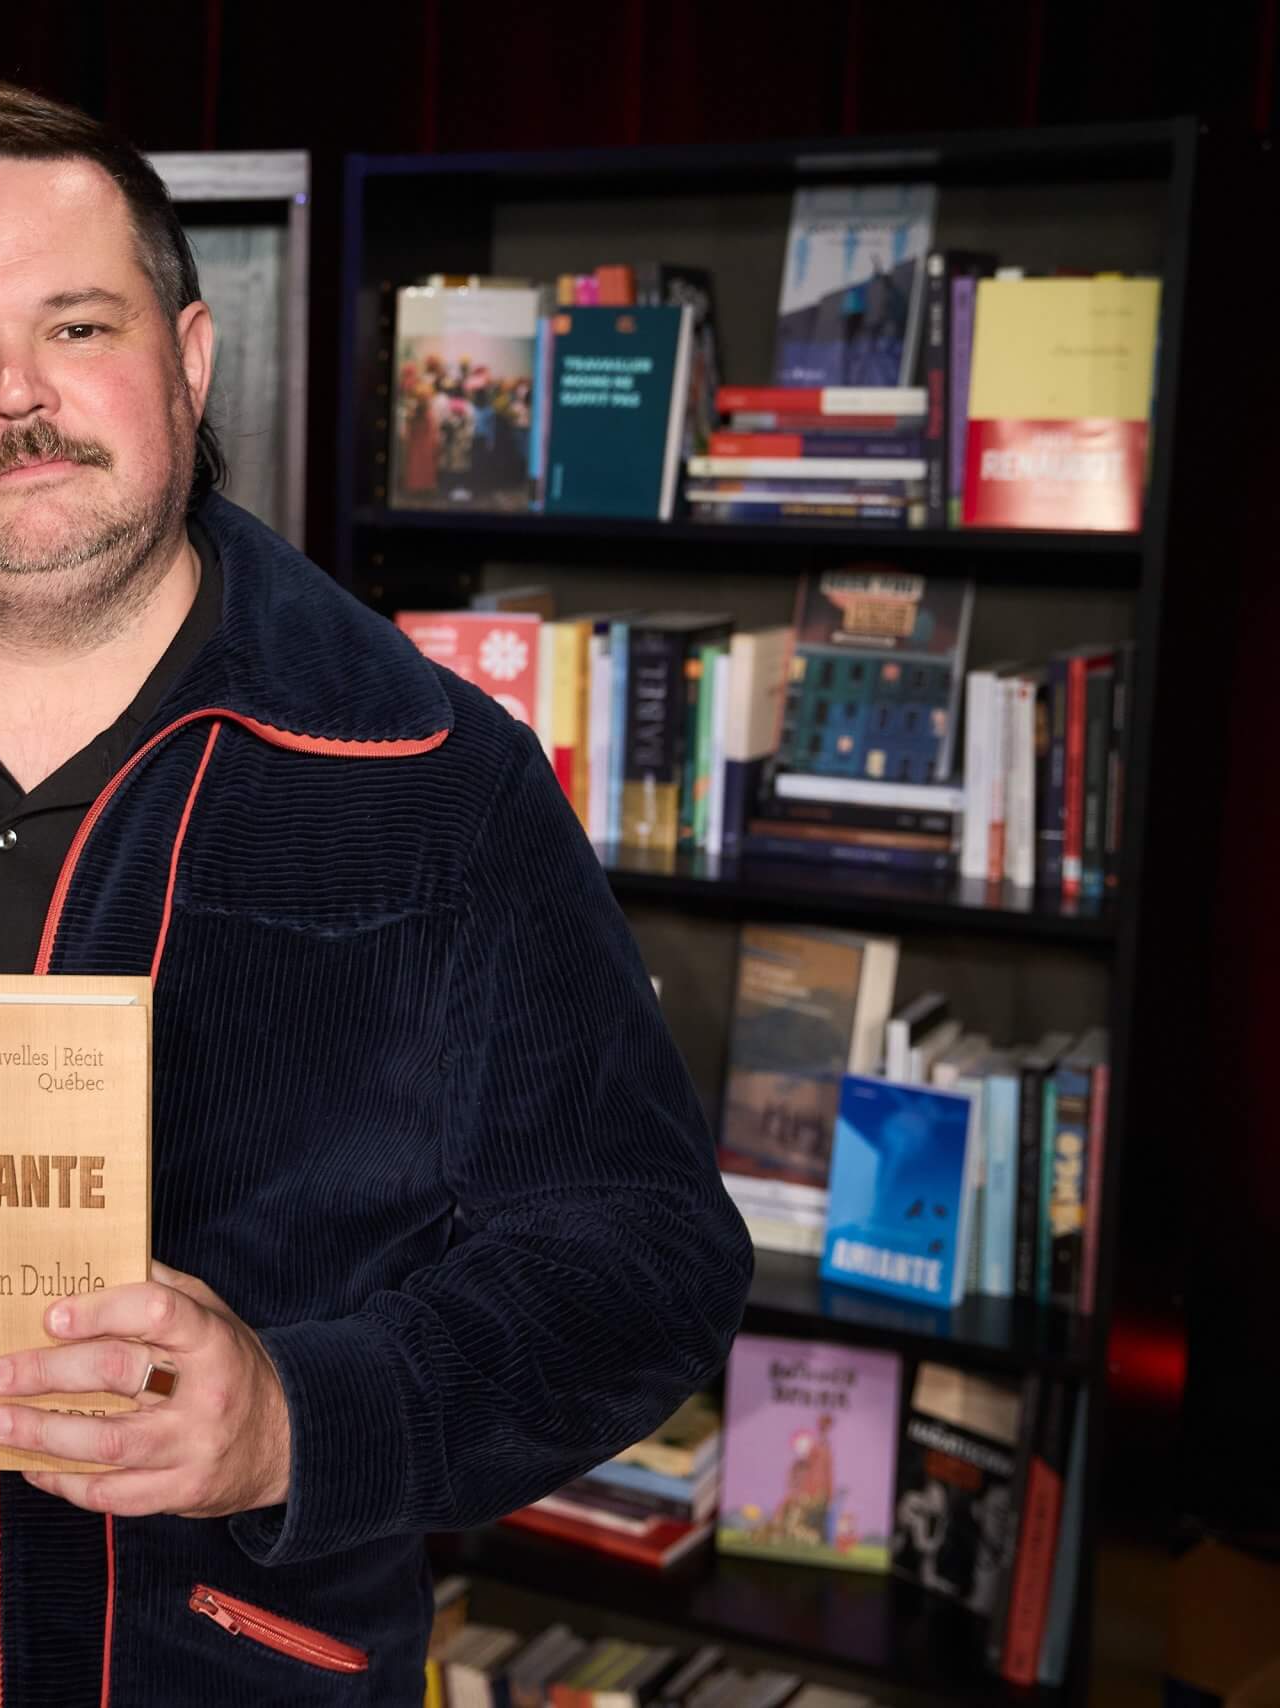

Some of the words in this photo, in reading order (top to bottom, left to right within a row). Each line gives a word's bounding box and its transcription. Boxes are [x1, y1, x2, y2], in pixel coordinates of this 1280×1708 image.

[63, 1047, 104, 1067] Récit
[38, 1072, 105, 1093] Québec
[831, 1238, 943, 1293] AMIANTE
